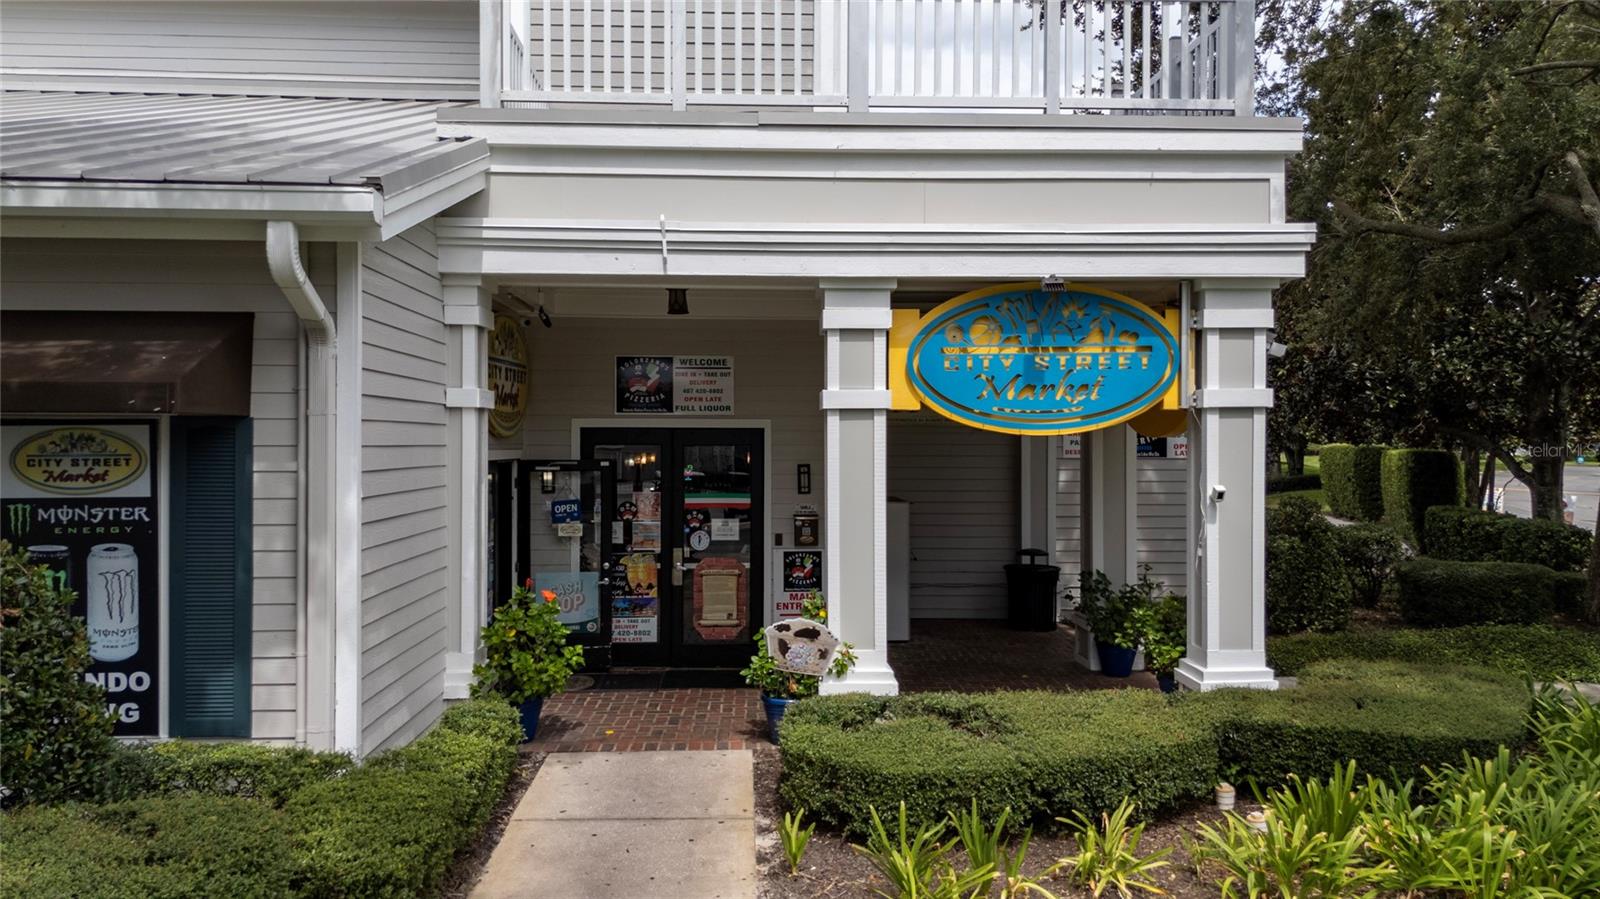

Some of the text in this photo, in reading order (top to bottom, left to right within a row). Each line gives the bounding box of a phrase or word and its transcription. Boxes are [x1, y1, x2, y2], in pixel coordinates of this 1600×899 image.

[679, 358, 728, 366] WELCOME
[943, 355, 1149, 371] CITY STREET
[504, 366, 527, 384] STREET
[974, 368, 1106, 404] Market
[624, 392, 665, 403] PIZZERIA
[27, 458, 132, 467] CITY STREET
[42, 467, 109, 483] Market
[37, 505, 150, 524] MONSTER
[554, 503, 578, 513] OPEN
[54, 526, 134, 534] ENERGY
